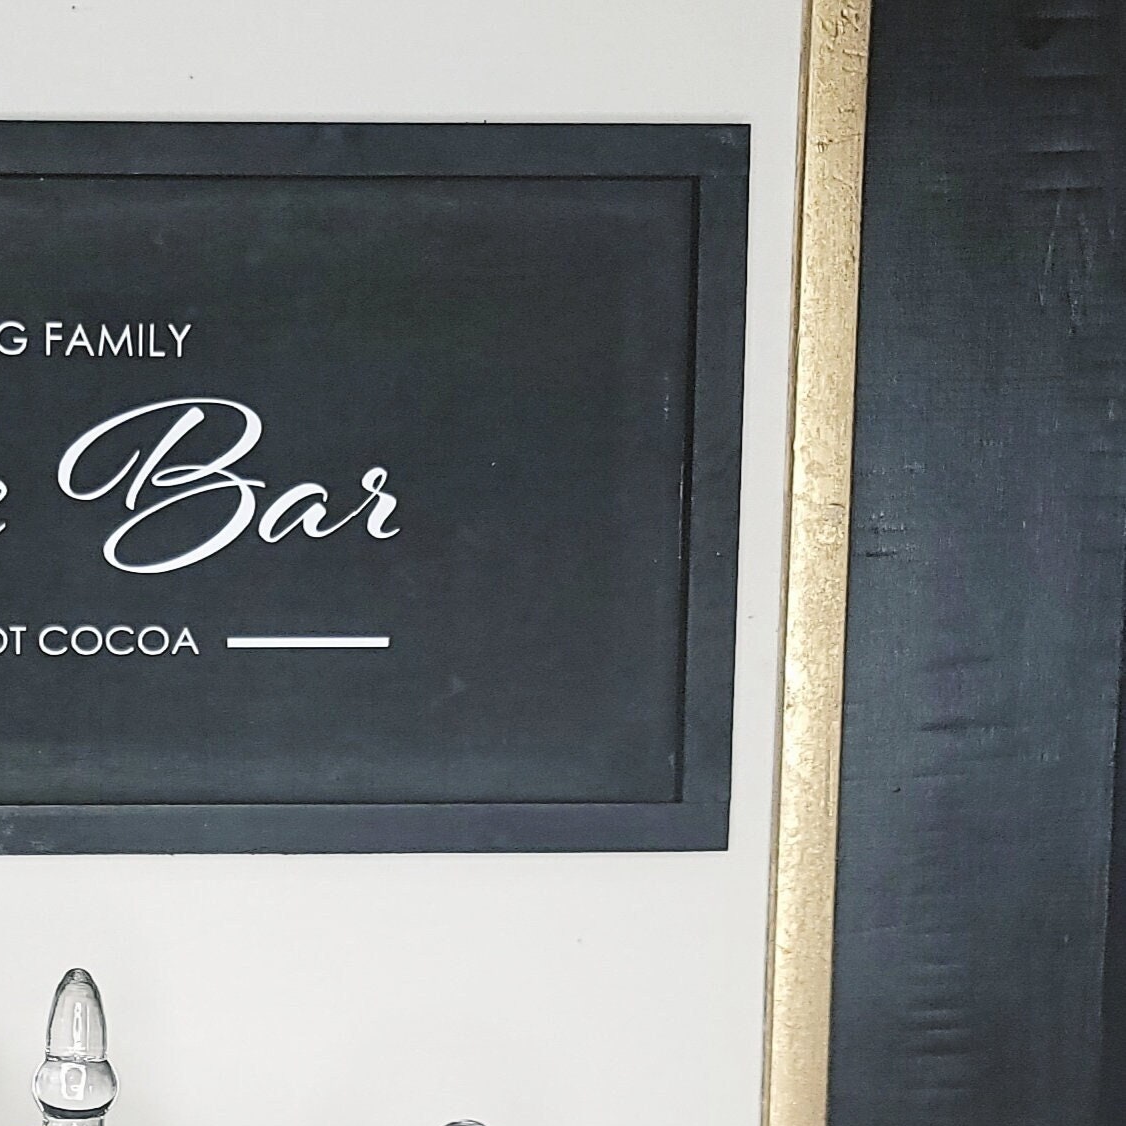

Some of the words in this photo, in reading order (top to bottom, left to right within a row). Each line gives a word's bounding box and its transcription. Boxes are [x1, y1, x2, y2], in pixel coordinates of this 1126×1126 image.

[45, 321, 192, 358] FAMILY
[57, 397, 401, 574] Bar
[38, 625, 200, 656] COCOA
